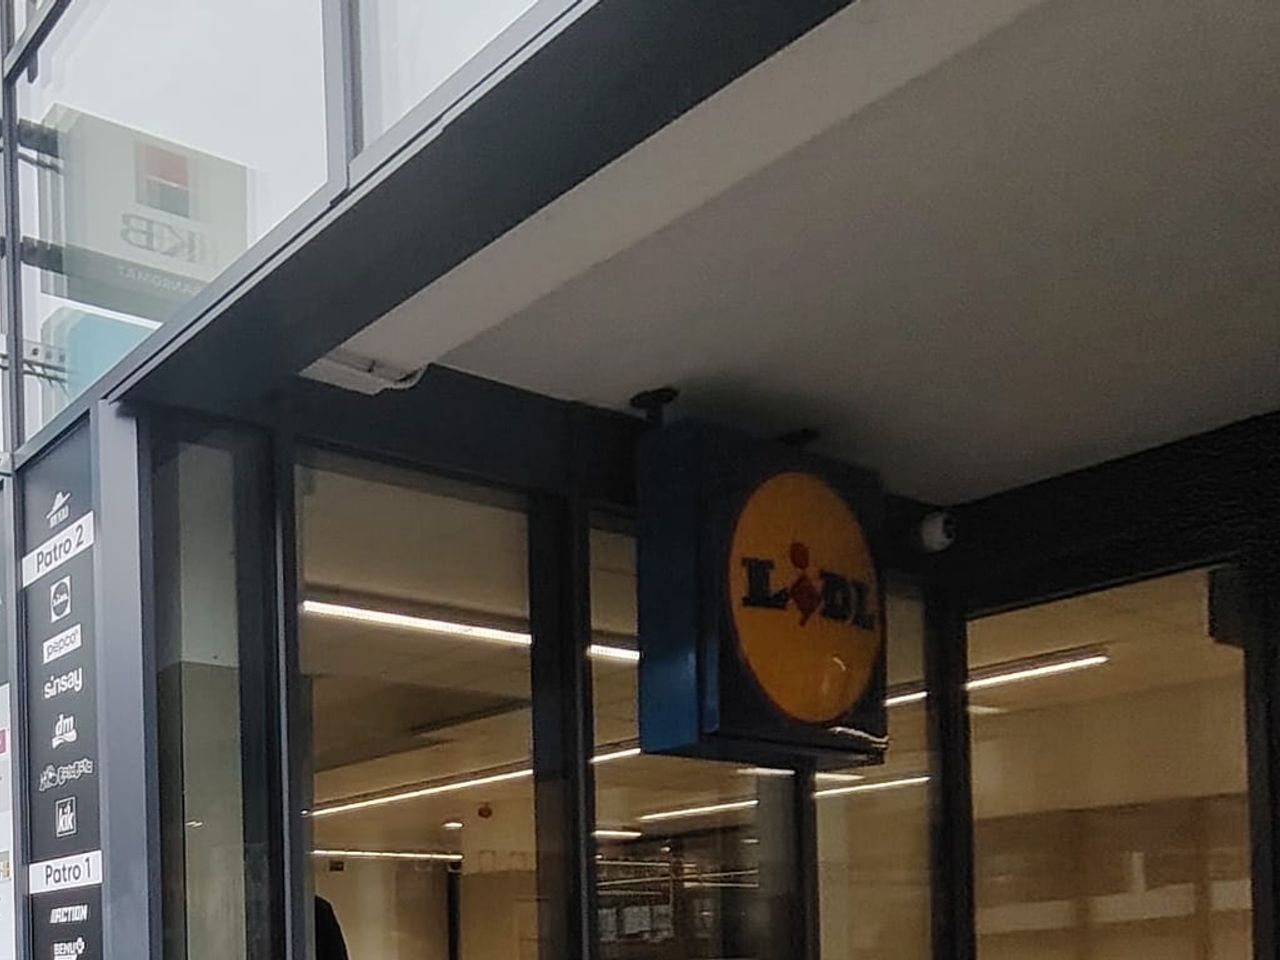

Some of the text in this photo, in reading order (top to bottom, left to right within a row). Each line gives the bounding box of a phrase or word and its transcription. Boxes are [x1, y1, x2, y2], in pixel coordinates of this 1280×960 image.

[36, 523, 84, 573] Patro 2
[43, 667, 83, 699] sinsay
[44, 856, 92, 886] Patro 1
[52, 904, 88, 924] ACTION
[53, 941, 77, 955] BENU
